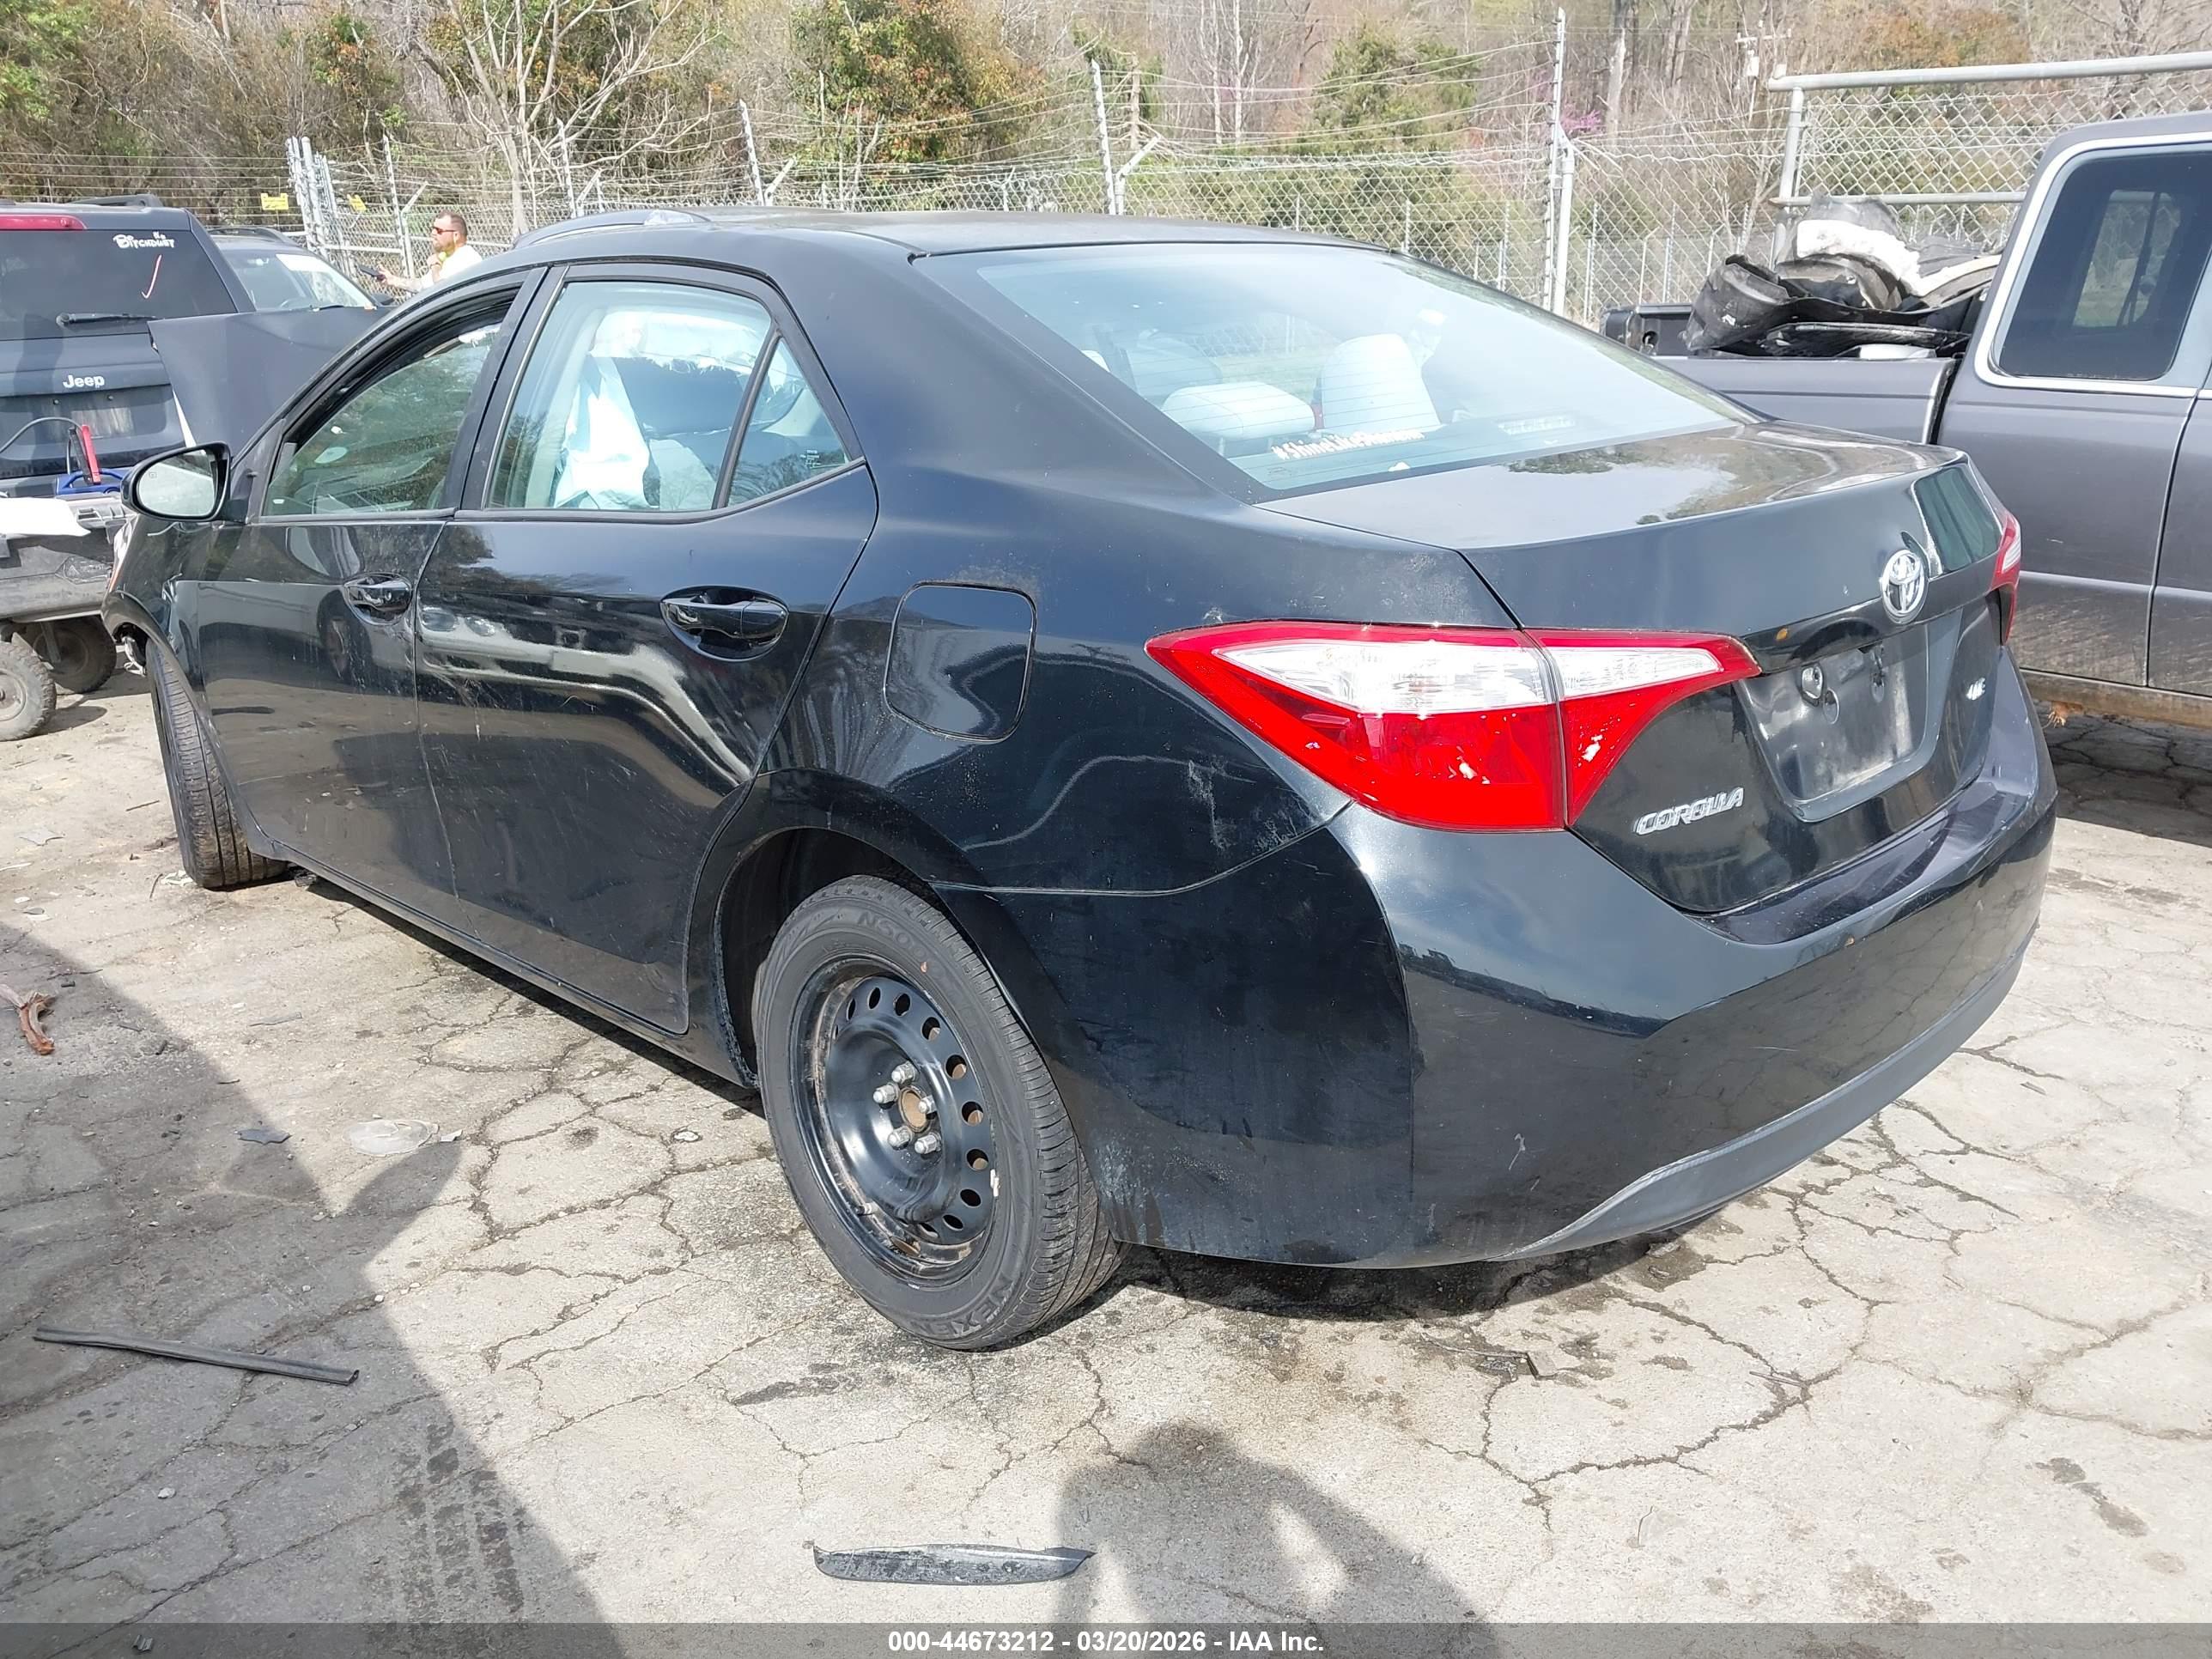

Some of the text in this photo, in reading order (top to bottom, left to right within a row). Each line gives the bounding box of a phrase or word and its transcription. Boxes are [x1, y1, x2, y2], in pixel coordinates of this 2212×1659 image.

[62, 374, 106, 388] Jeep
[1633, 787, 1745, 836] COROLLA
[909, 1275, 1016, 1337] NEXEN
